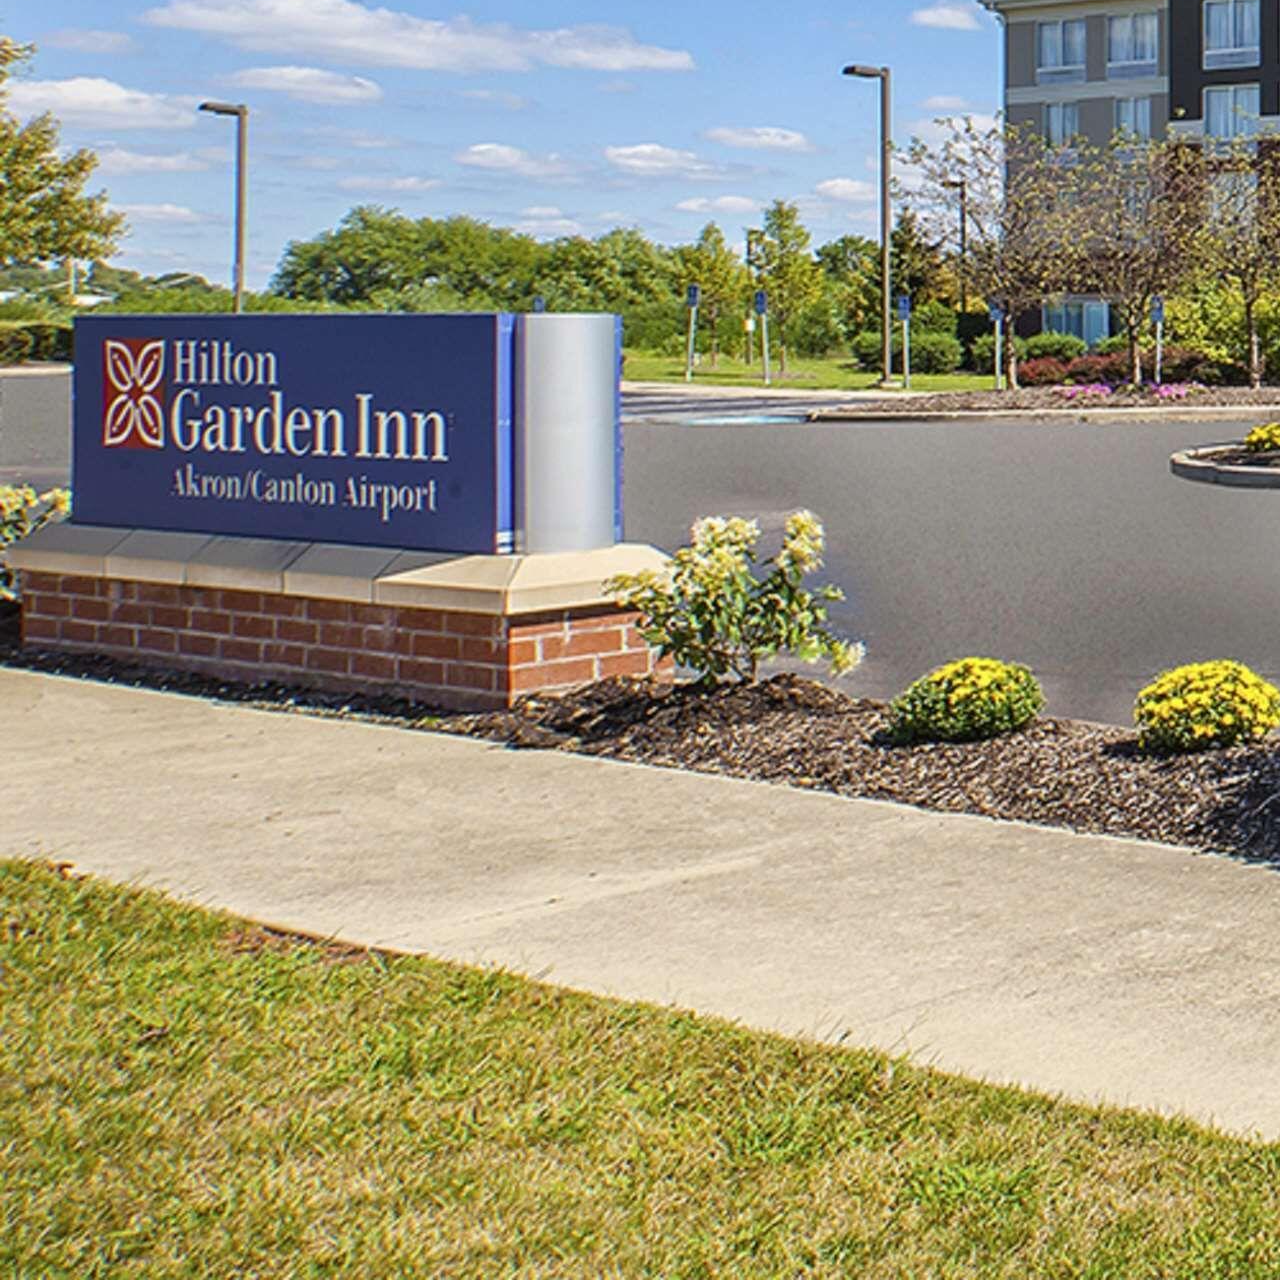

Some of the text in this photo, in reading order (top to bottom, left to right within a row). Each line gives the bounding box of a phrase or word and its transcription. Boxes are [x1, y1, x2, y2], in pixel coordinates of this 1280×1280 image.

[174, 340, 278, 385] Hilton
[171, 389, 449, 461] Garden Inn
[170, 463, 437, 521] Akron/Canton Airport
